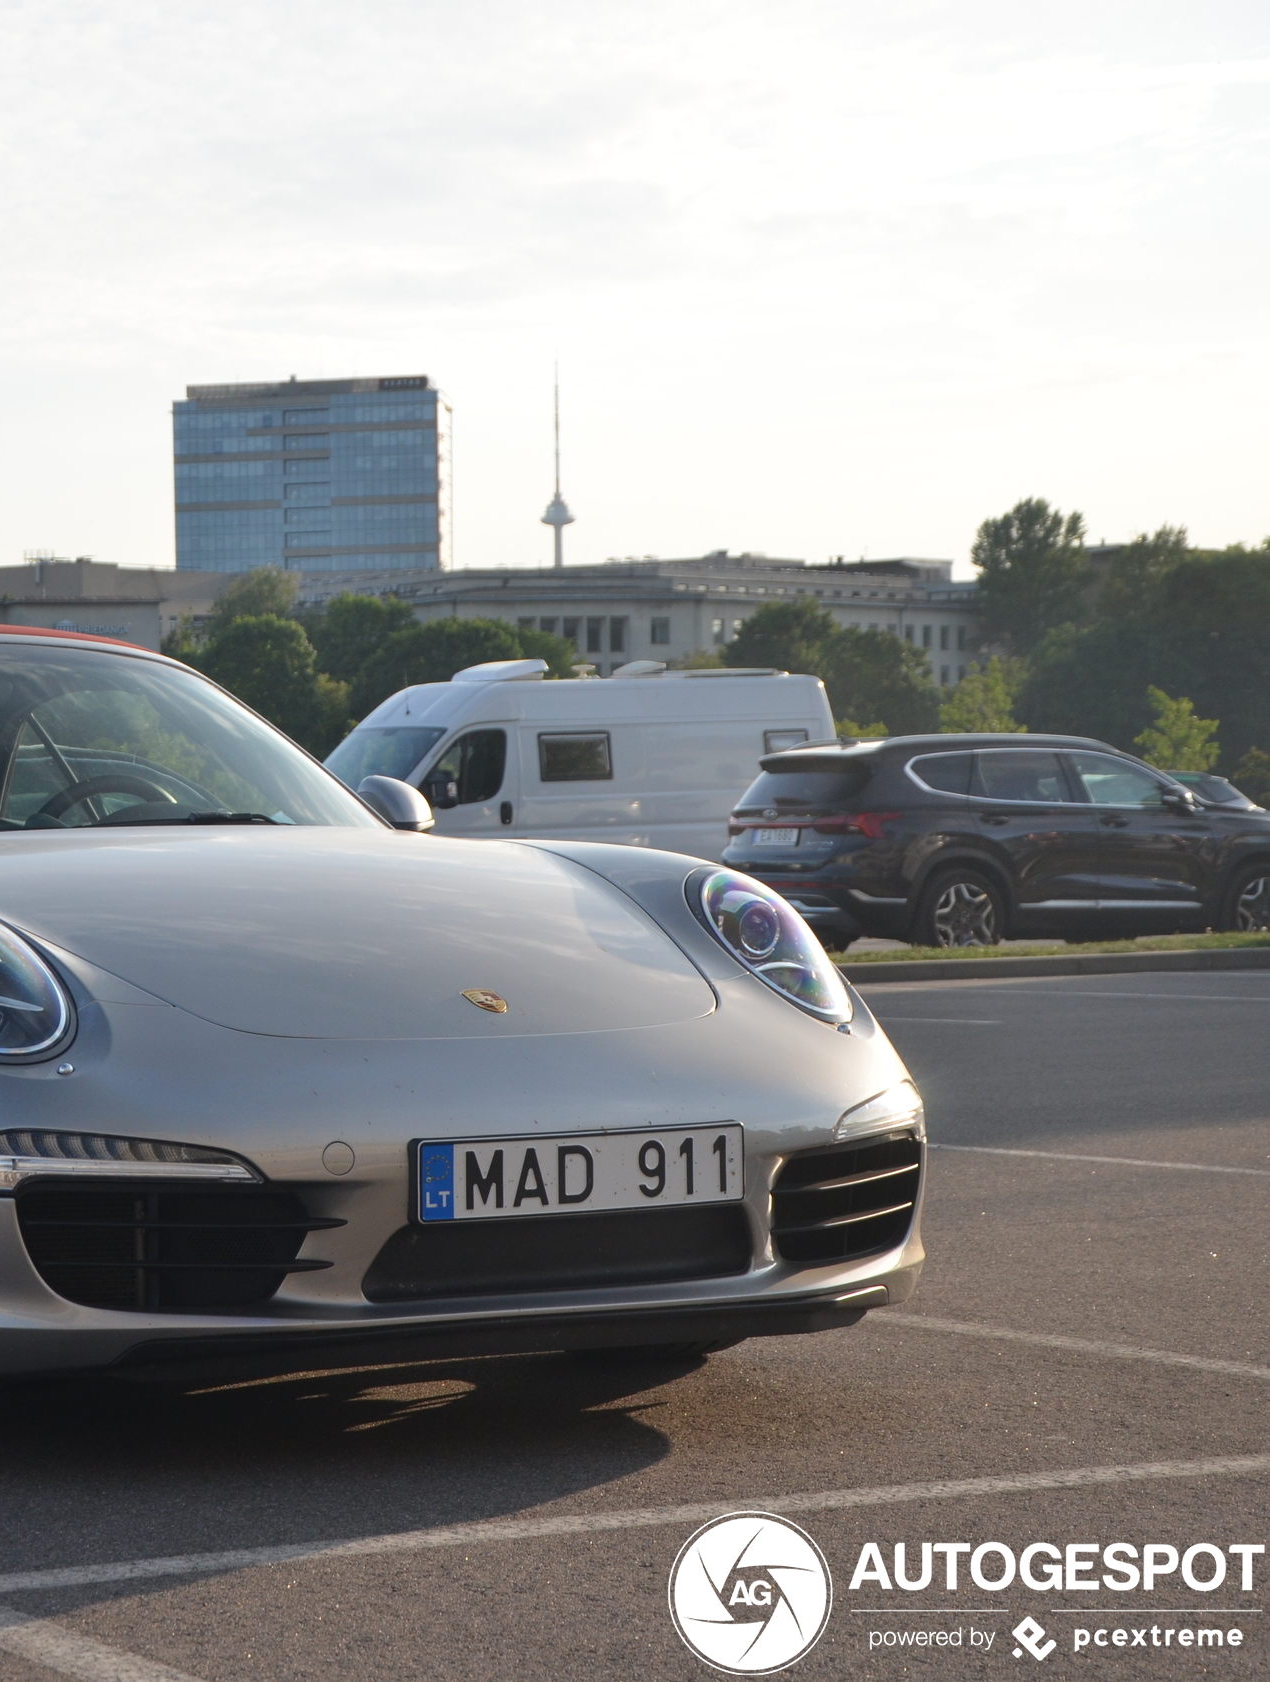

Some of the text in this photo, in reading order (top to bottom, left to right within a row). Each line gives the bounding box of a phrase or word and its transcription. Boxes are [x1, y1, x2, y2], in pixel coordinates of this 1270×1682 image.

[78, 625, 129, 634] PRIEDANGA
[465, 1133, 728, 1210] MAD 911
[425, 1190, 451, 1208] LT
